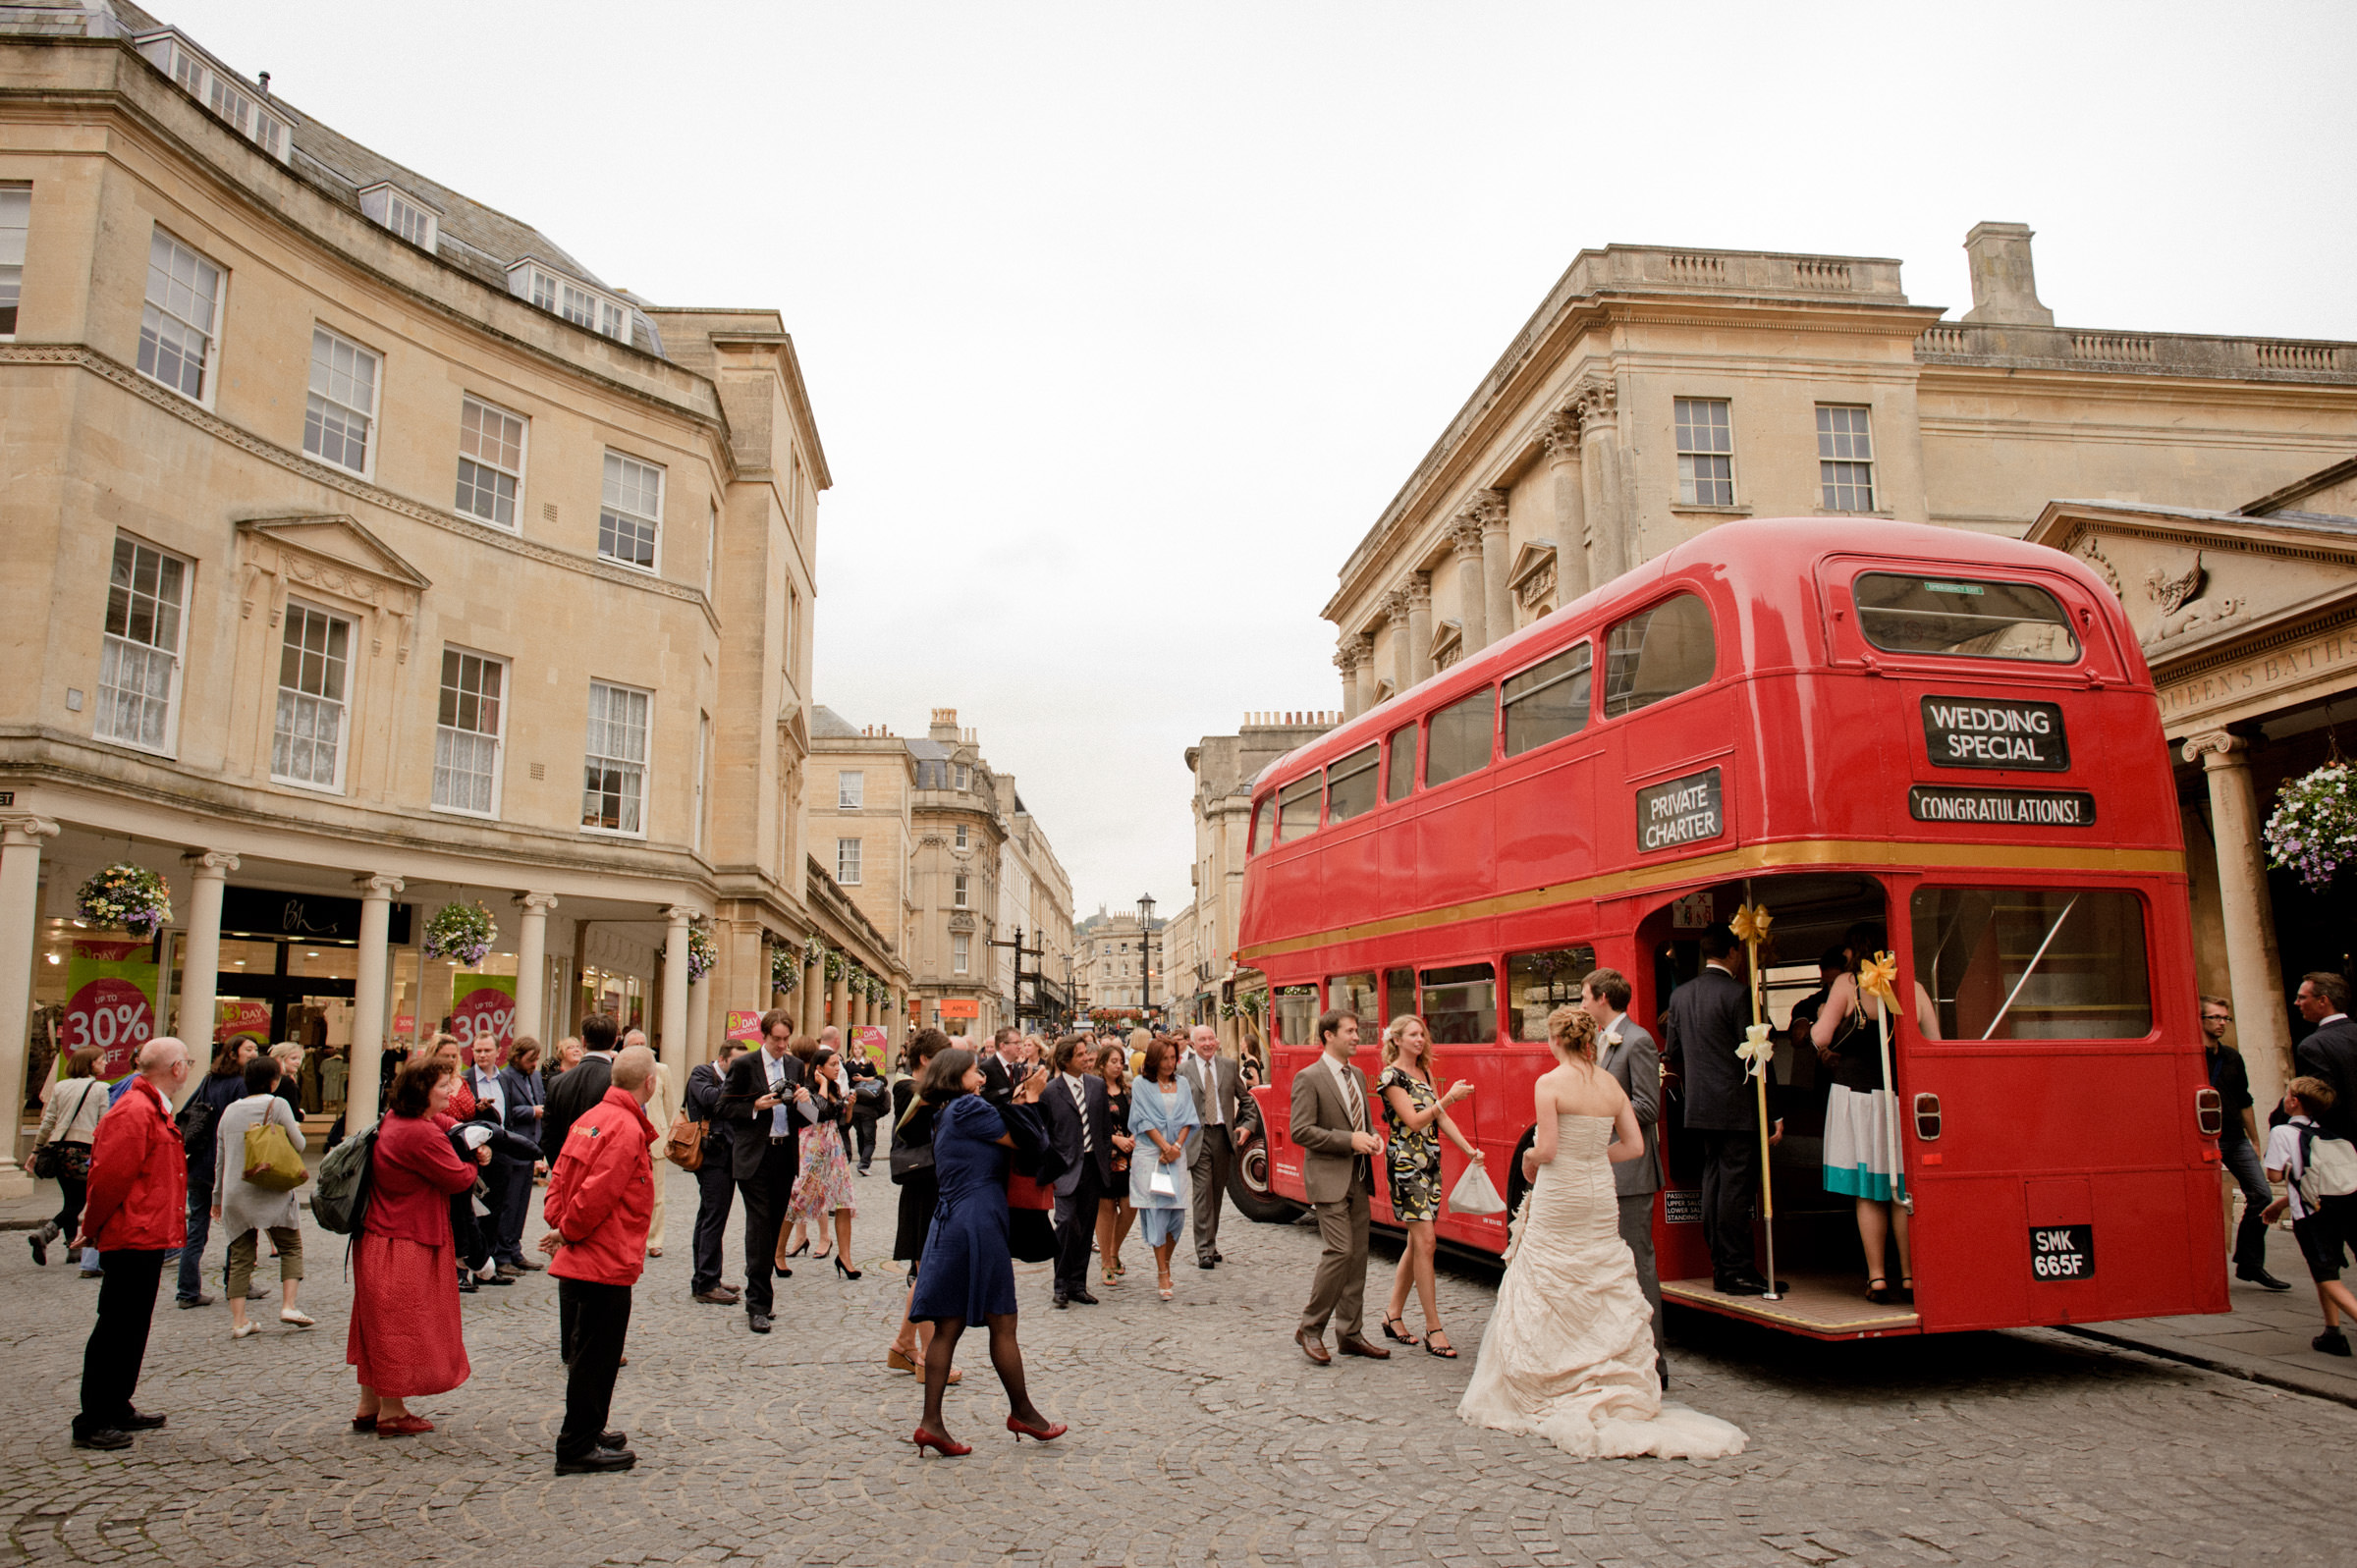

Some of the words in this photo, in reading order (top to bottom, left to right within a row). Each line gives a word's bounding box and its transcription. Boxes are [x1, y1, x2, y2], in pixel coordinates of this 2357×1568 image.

[1930, 705, 2050, 733] WEDDING
[1947, 734, 2044, 761] SPECIAL
[1651, 784, 1709, 820] PRIVATE
[1921, 796, 2080, 823] CONGRATULATIONS!
[1646, 811, 1716, 847] CHARTER
[283, 899, 338, 933] Bhs
[107, 994, 118, 1002] TO
[68, 1001, 149, 1051] 30%
[242, 1008, 262, 1020] DAY
[456, 1006, 515, 1048] 30%
[742, 1017, 758, 1029] DAY
[2036, 1230, 2074, 1251] SMK
[2035, 1254, 2083, 1276] 665F
